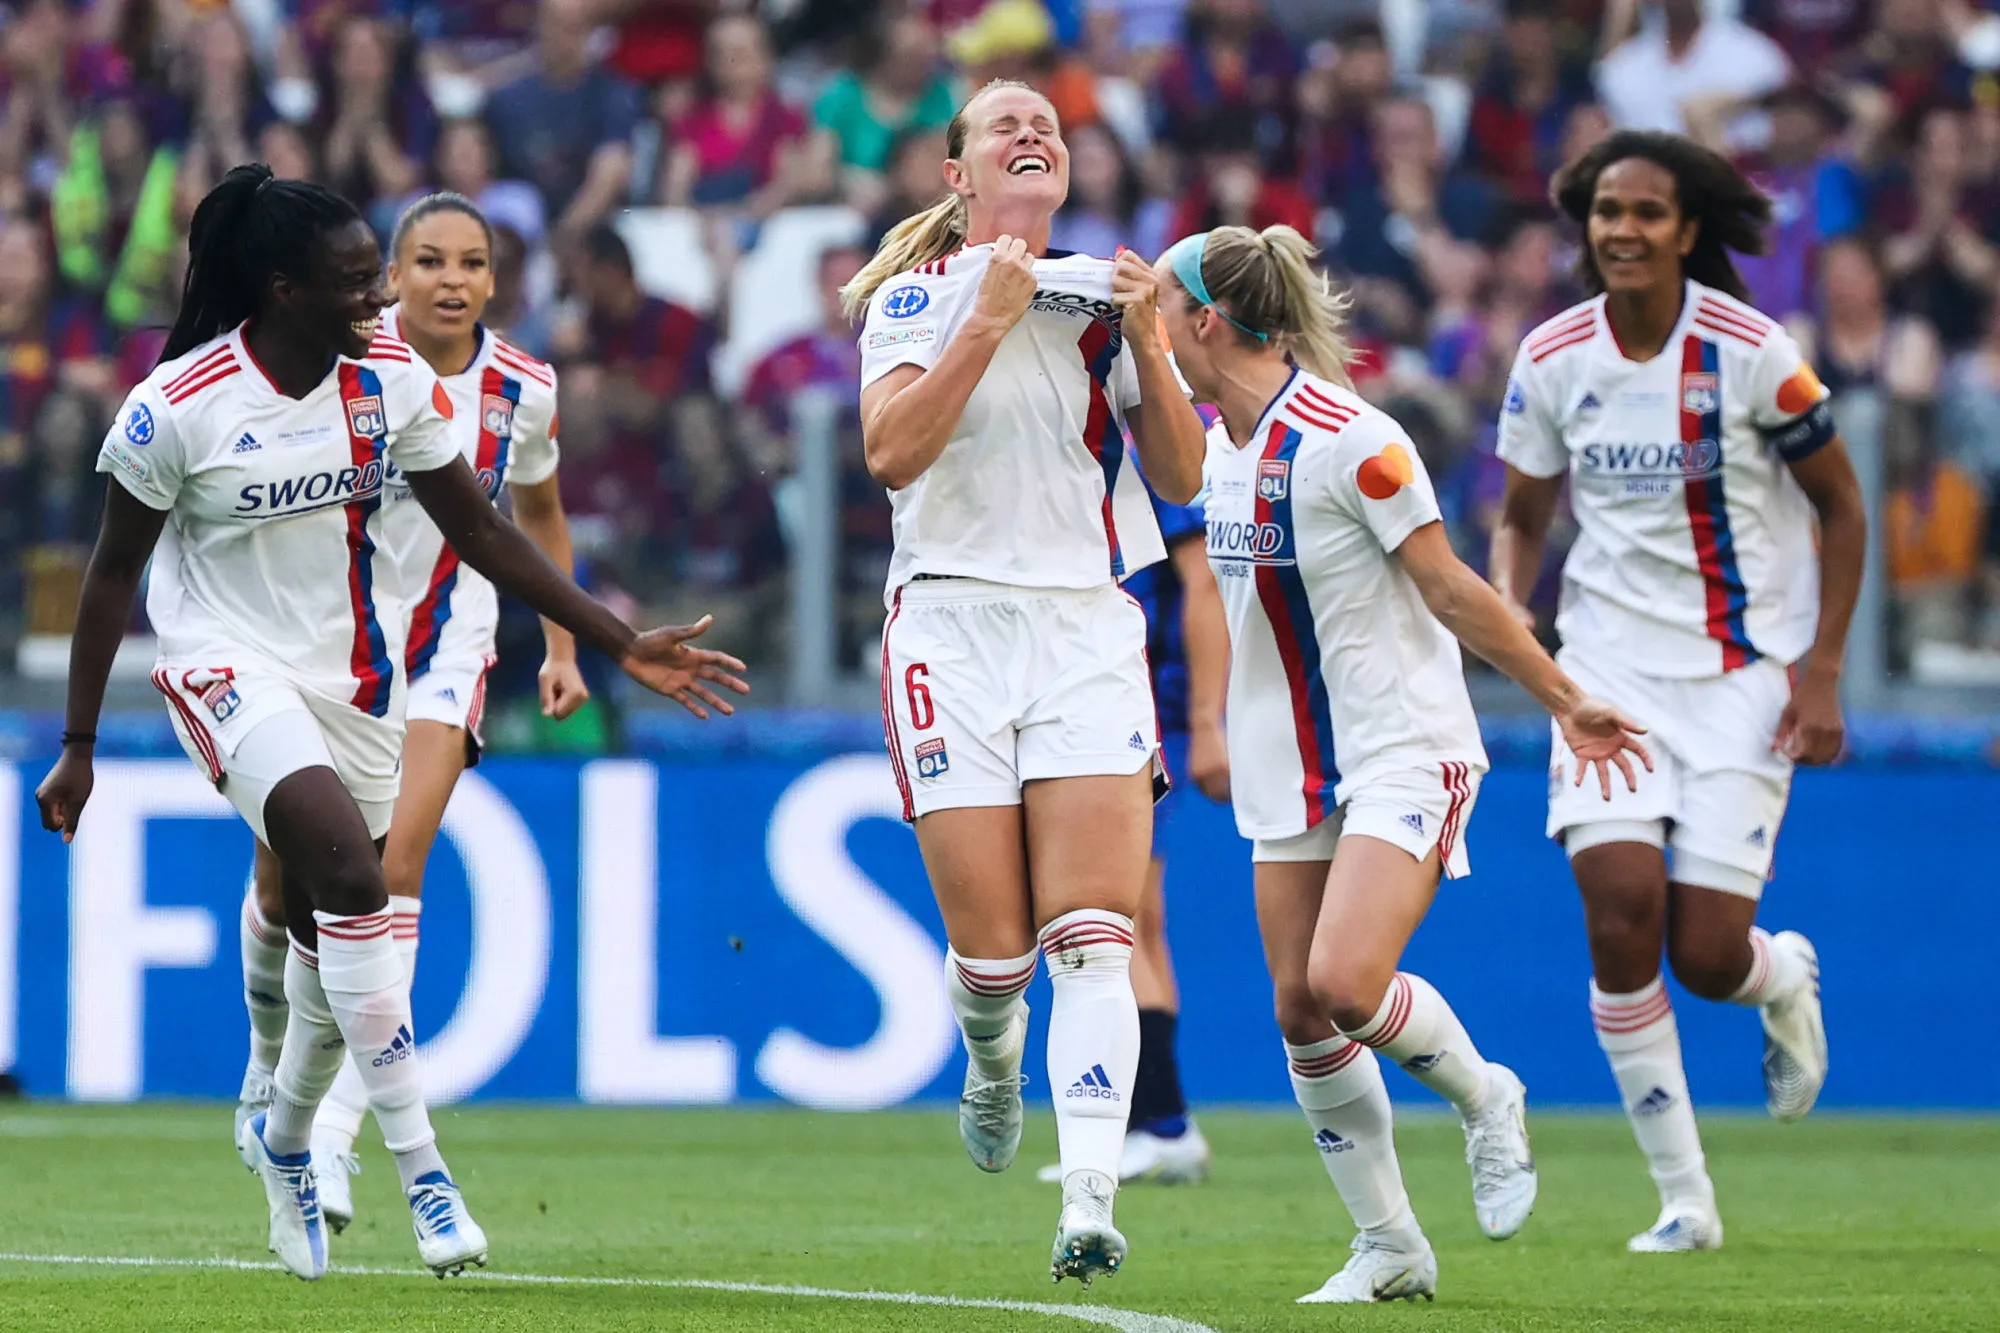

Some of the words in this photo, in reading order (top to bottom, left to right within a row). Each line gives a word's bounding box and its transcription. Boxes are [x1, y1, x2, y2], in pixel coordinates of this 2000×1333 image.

[869, 329, 934, 345] FOUNDATION
[1584, 439, 1718, 470] SWORD
[235, 460, 383, 511] SWORD
[1206, 520, 1284, 555] WORD
[905, 663, 934, 730] 6
[920, 755, 947, 774] OL
[1066, 1085, 1120, 1101] adidas
